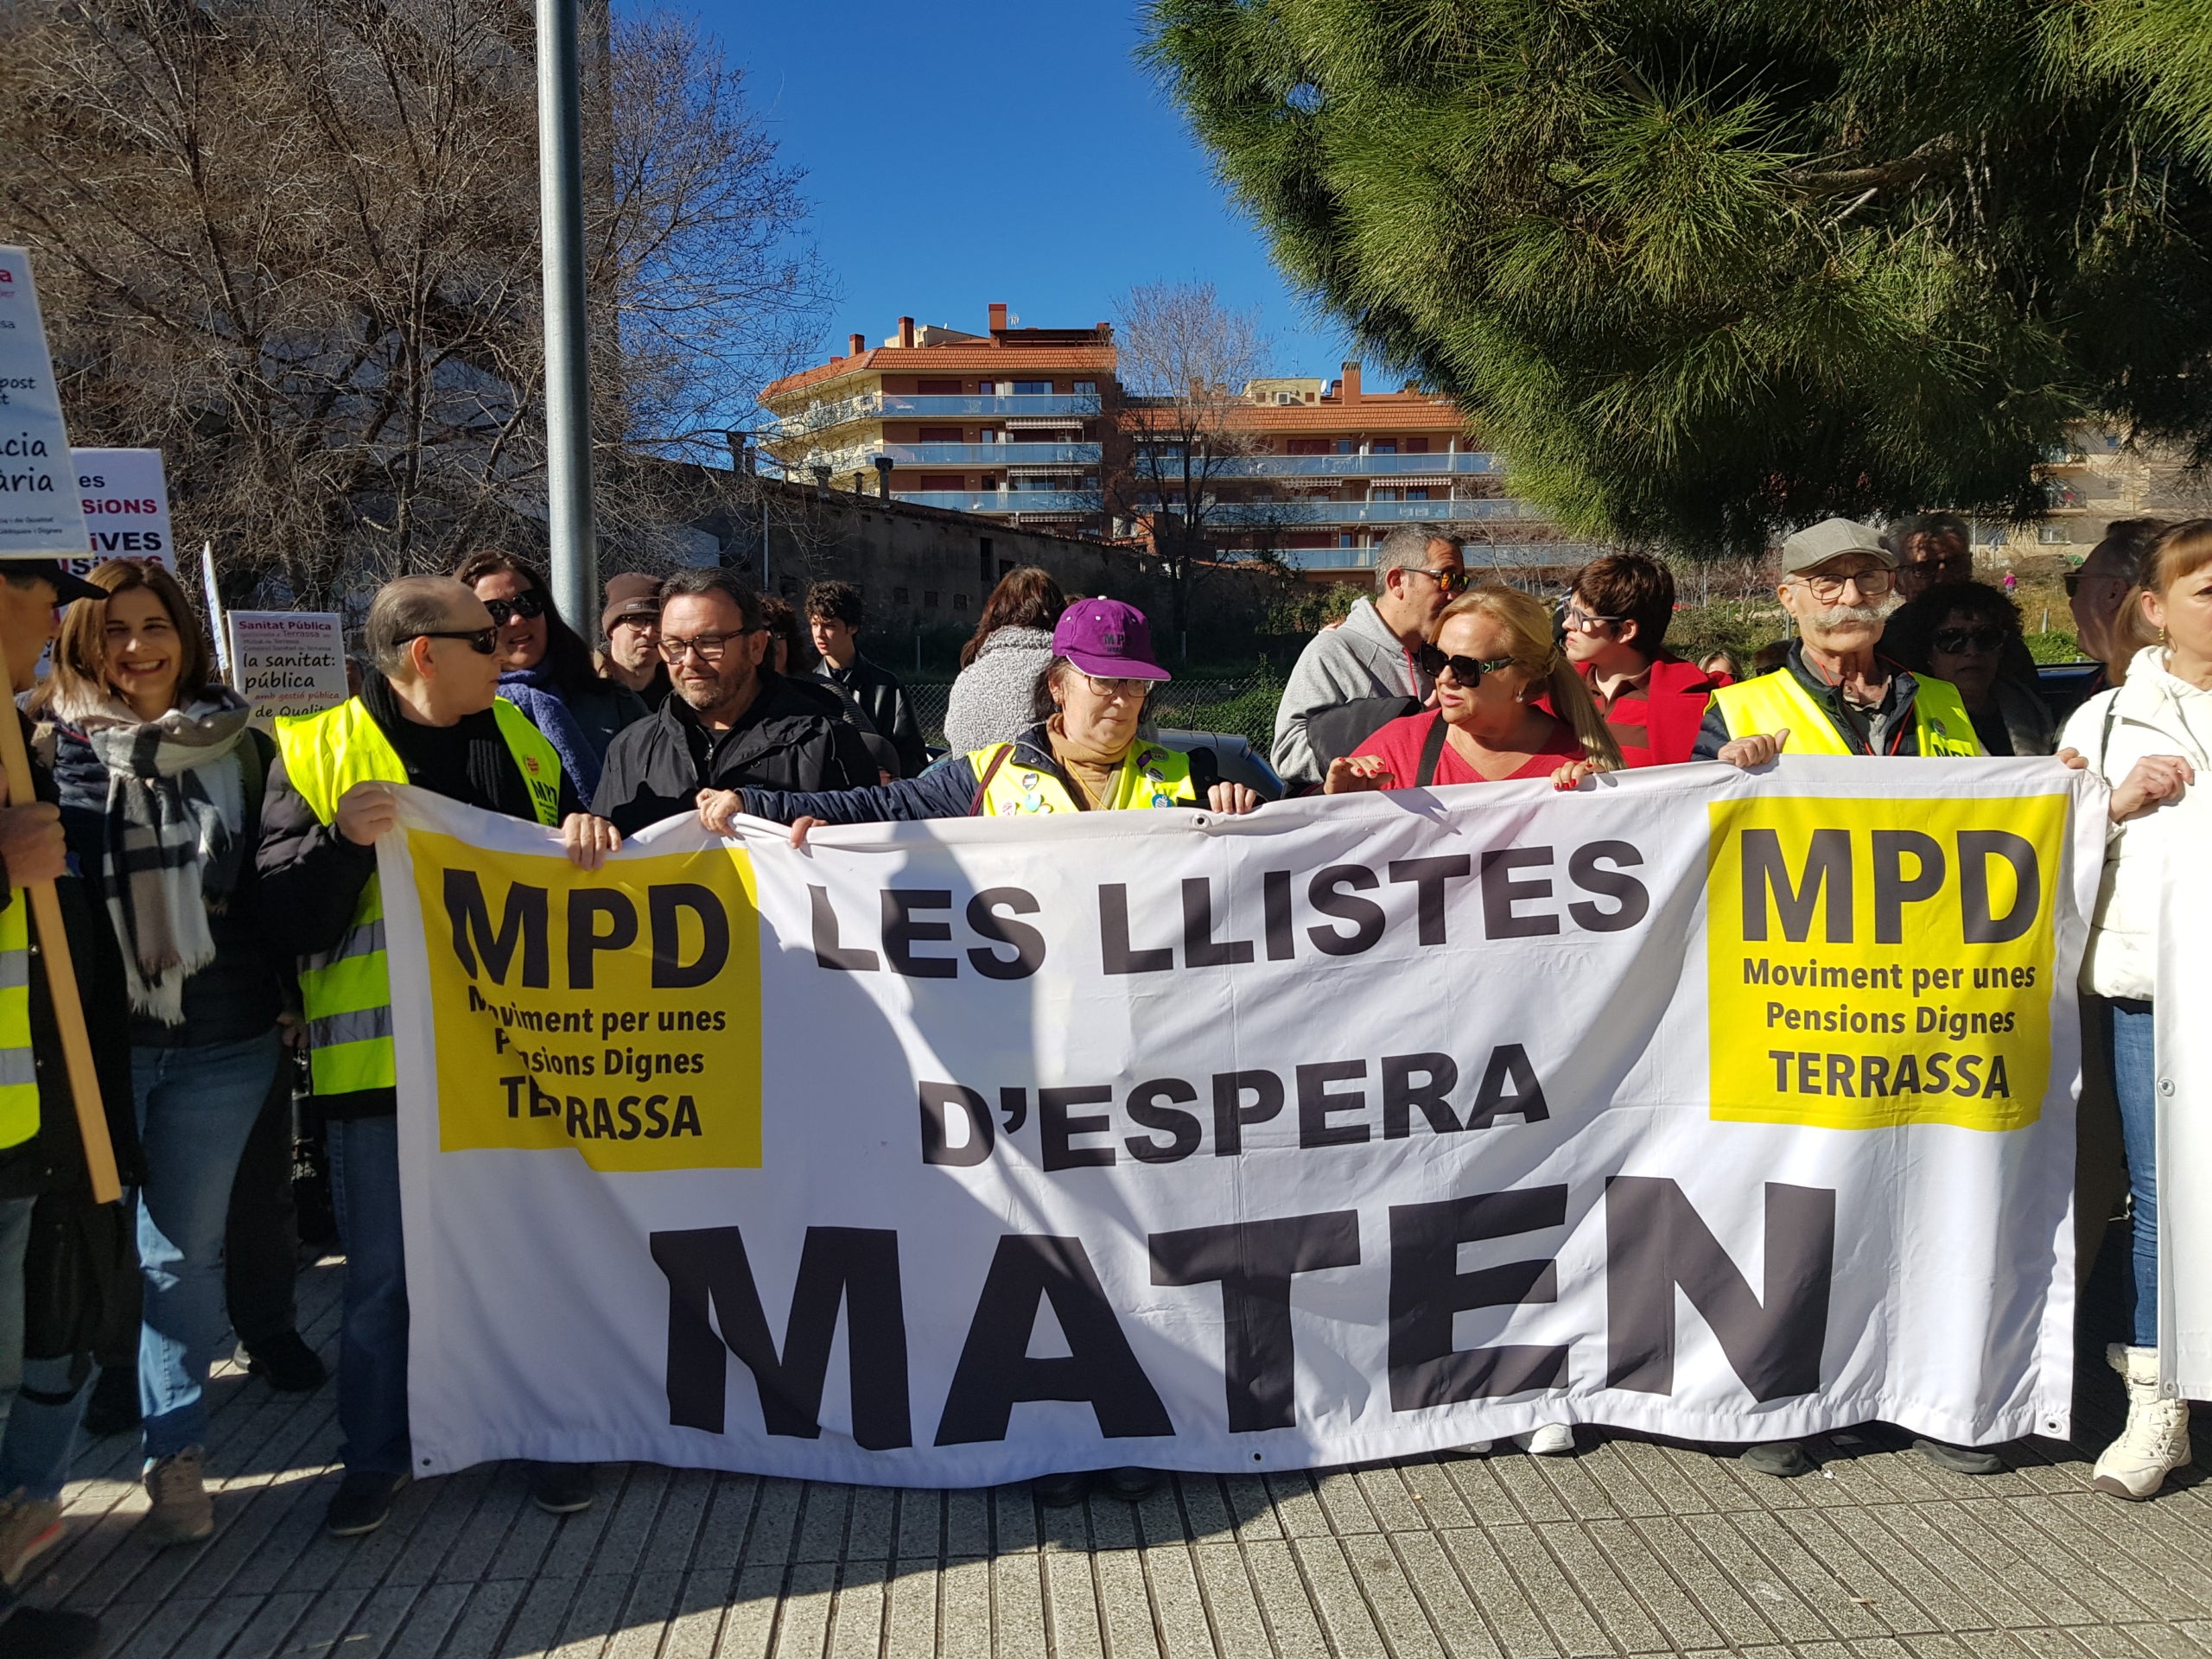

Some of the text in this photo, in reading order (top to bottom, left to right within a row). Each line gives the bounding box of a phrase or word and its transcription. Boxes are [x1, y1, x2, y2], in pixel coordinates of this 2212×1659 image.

[238, 620, 332, 631] Sanitat Pública
[244, 652, 335, 668] la sanitat:
[245, 671, 315, 694] pública
[278, 692, 305, 702] gestió
[308, 691, 340, 702] pública
[255, 705, 273, 718] de
[1741, 829, 2041, 944] MPD
[443, 868, 730, 989] MPD
[806, 840, 1650, 981] LES LLISTES
[1743, 958, 2036, 998] Moviment per unes
[602, 1011, 650, 1041] per
[658, 1010, 726, 1032] unes
[1767, 1001, 2016, 1041] Pensions Dignes
[494, 1027, 705, 1083] Pnsions Dignes
[1768, 1050, 2012, 1099] TERRASSA
[650, 1174, 1837, 1458] MATEN
